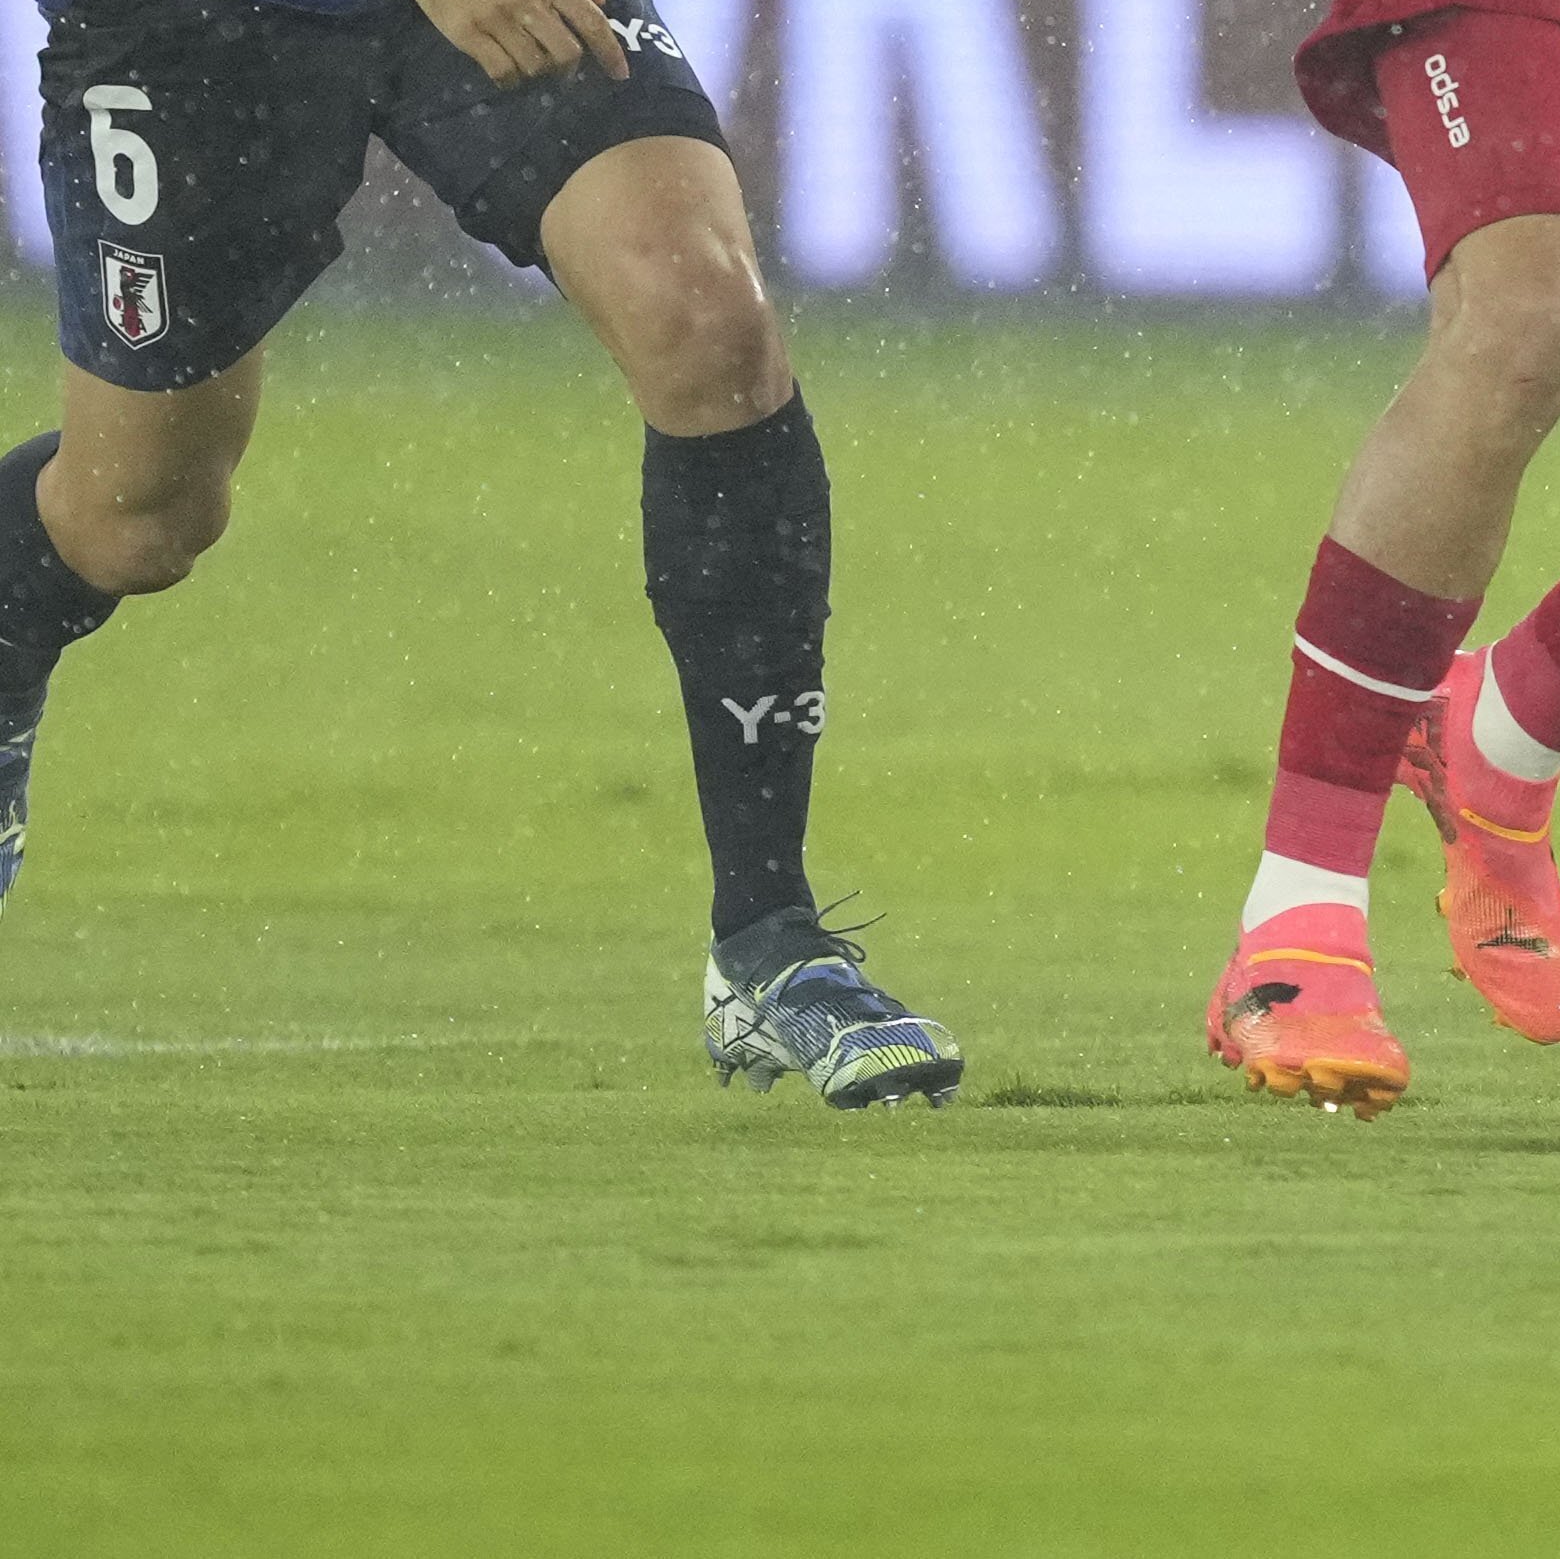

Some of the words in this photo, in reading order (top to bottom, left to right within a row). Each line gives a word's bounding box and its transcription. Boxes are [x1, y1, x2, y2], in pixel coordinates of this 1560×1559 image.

[607, 18, 683, 59] Y-3
[1425, 53, 1471, 148] erspo
[82, 84, 159, 226] 6
[113, 249, 145, 265] JAPAN
[721, 689, 827, 745] Y-3
